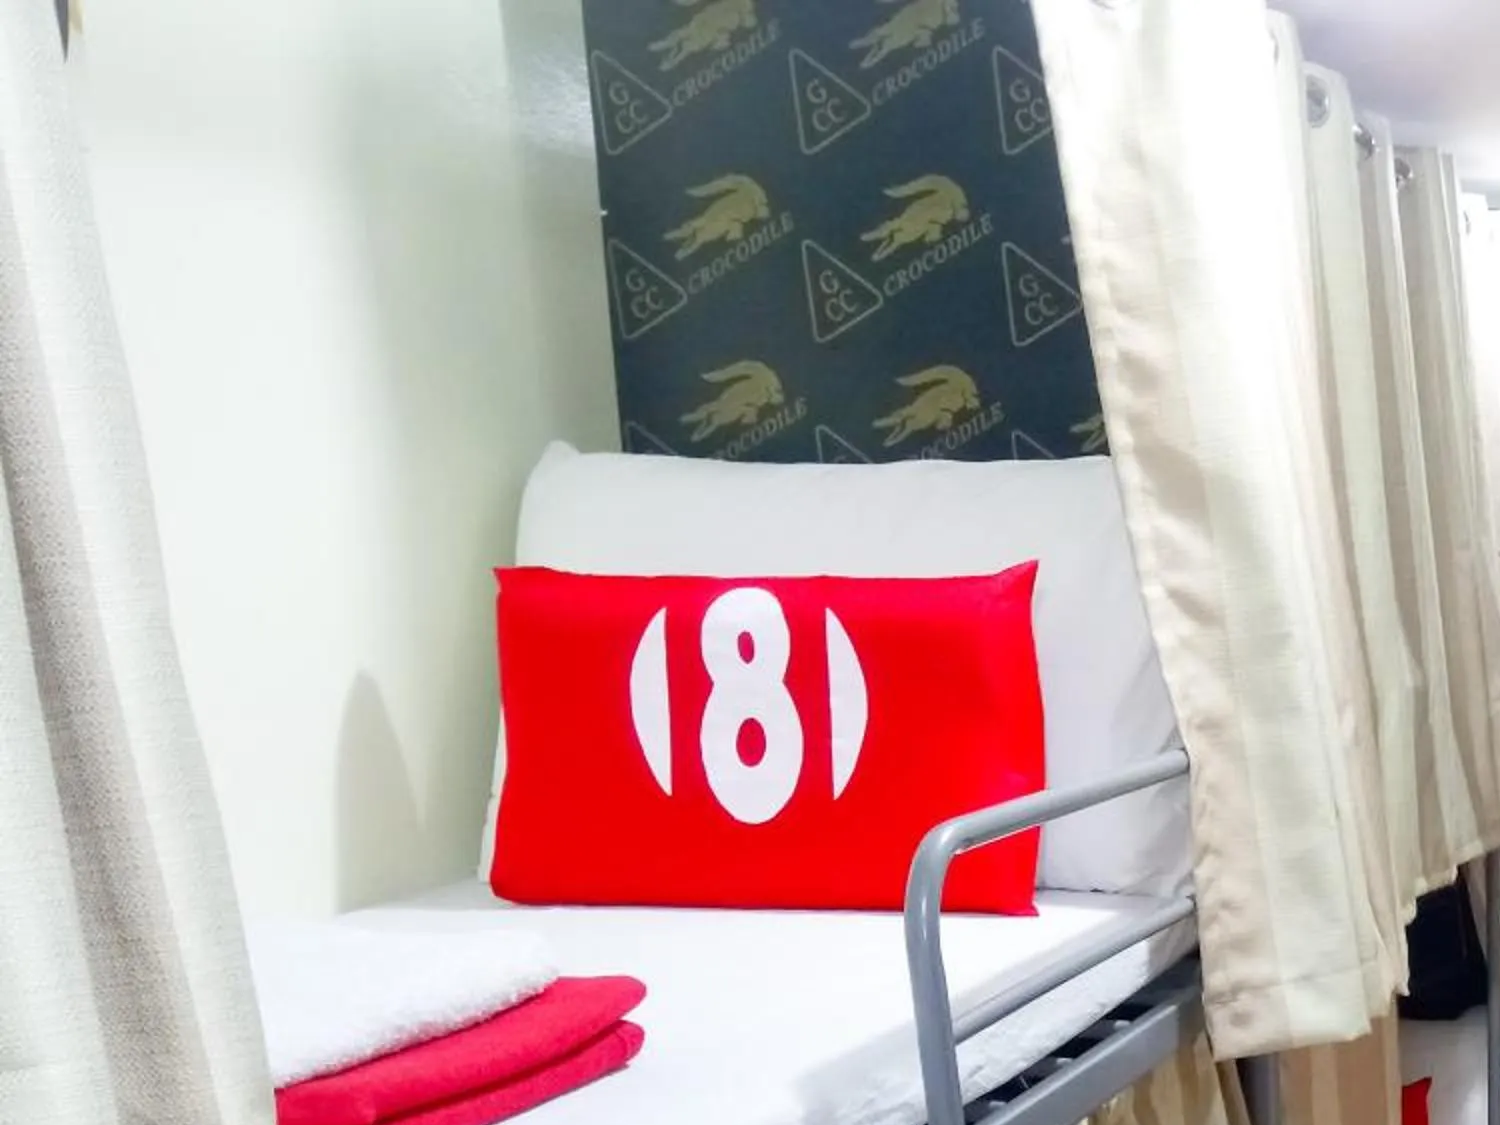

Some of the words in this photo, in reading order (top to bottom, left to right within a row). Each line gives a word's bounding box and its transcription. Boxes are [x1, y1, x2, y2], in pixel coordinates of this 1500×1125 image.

[672, 17, 781, 107] CROCODILE
[872, 17, 986, 107] CROCODILE
[687, 210, 795, 295] CROCODILE
[882, 213, 995, 297] CROCODILE
[711, 396, 808, 460] OCODILE
[906, 401, 1005, 462] OCODILE
